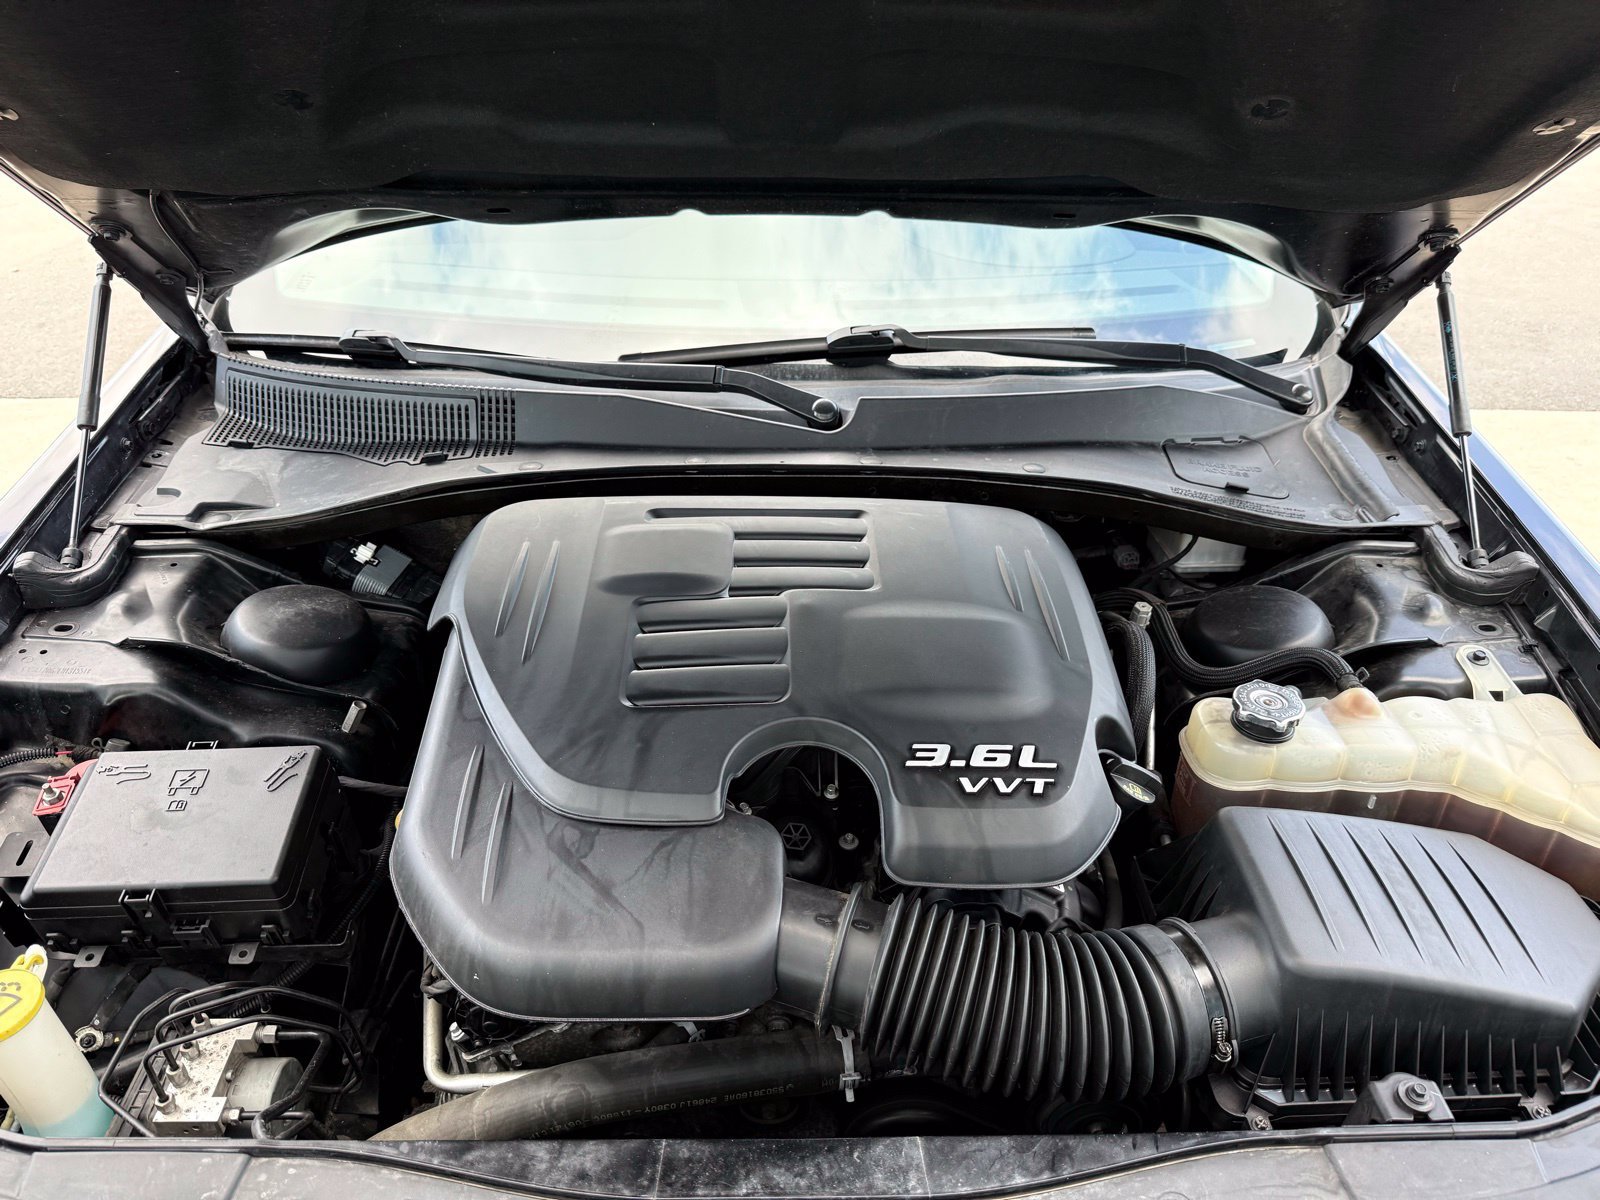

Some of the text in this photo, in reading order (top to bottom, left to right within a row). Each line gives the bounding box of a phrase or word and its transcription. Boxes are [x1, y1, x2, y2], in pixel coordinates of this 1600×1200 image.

[1201, 466, 1250, 478] ACCESS
[1227, 463, 1263, 474] FLUID
[904, 743, 1058, 769] 3.6L
[957, 777, 1055, 795] VVT
